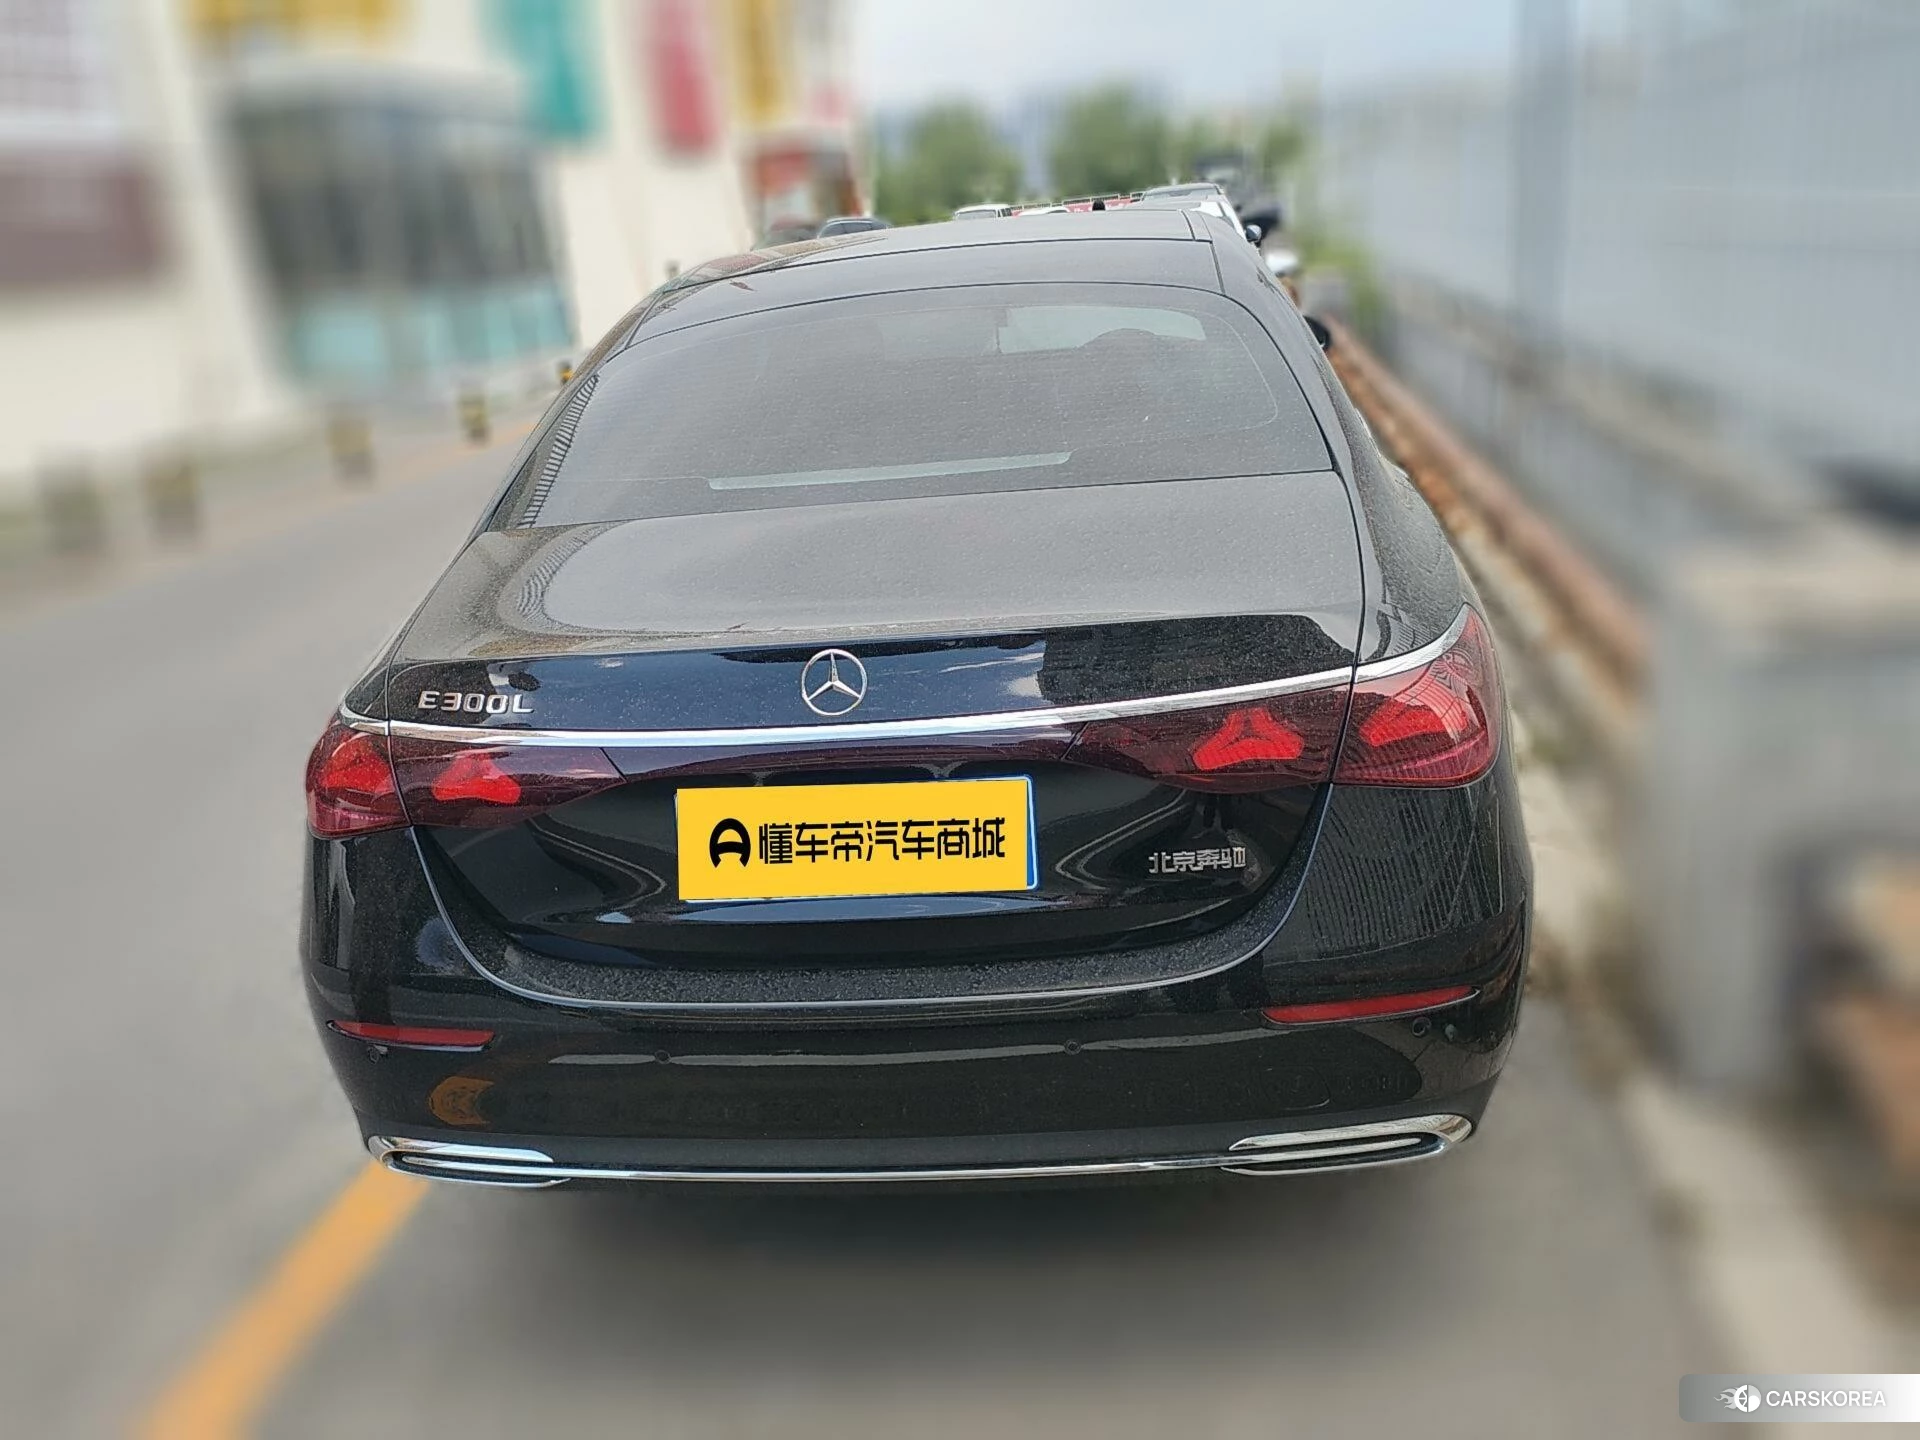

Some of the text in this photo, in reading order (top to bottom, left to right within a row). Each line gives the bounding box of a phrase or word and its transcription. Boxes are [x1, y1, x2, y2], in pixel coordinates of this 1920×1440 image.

[418, 690, 535, 714] E300L
[1148, 846, 1246, 873] 北京奔驰
